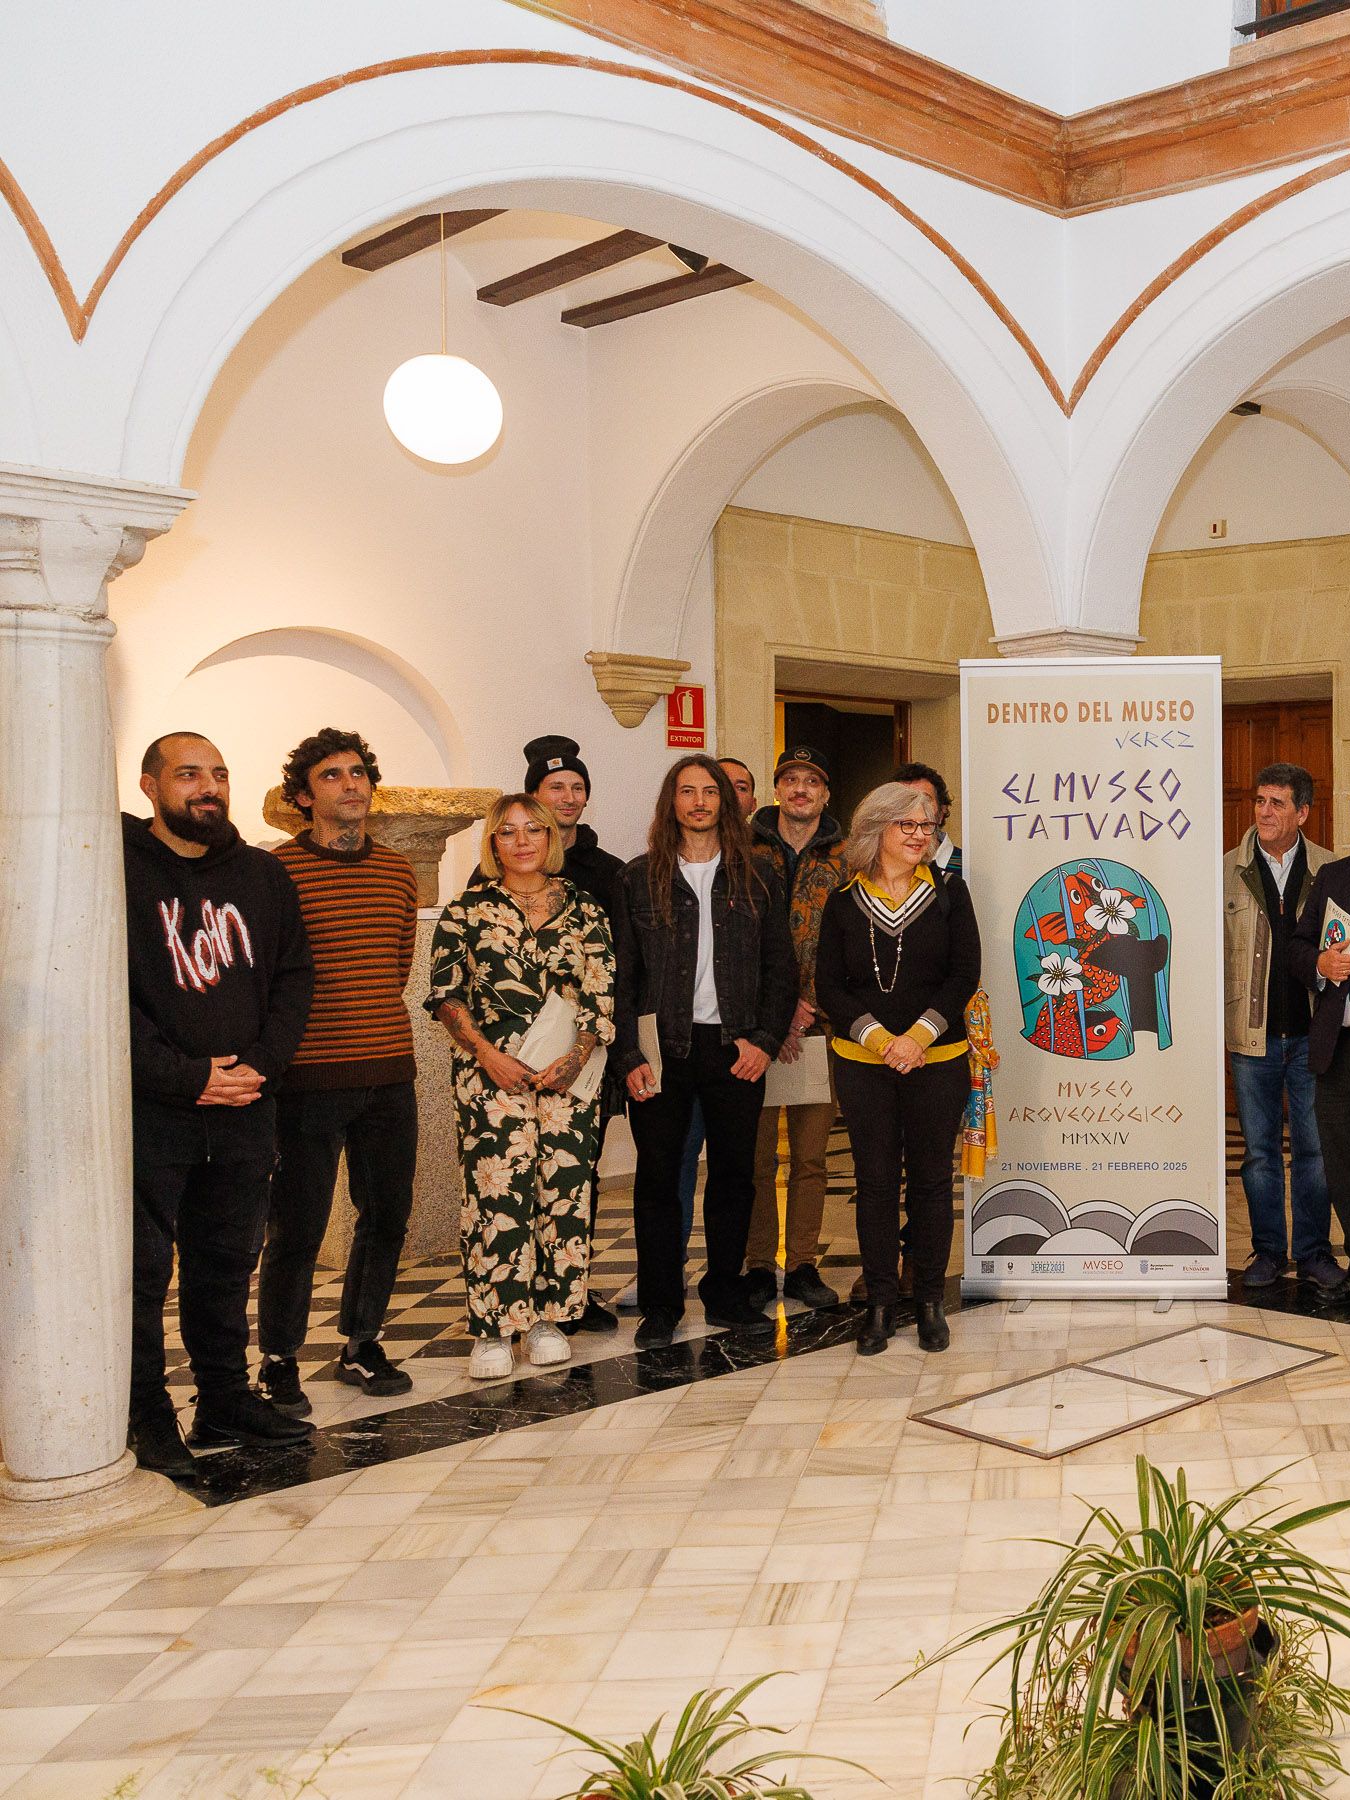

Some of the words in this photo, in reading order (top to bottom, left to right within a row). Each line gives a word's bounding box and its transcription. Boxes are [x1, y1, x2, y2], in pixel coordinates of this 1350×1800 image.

[987, 701, 1068, 723] DENTRO
[1078, 700, 1112, 722] DEL
[1122, 699, 1194, 722] MUSEO
[670, 735, 702, 743] EXTINTOR
[1002, 773, 1040, 804] EL
[1062, 1131, 1130, 1145] MMXXIV
[1001, 1162, 1012, 1171] 21
[1017, 1162, 1082, 1171] NOVIEMBRE
[1091, 1162, 1103, 1171] 21
[1107, 1161, 1159, 1171] FEBRERO
[1163, 1161, 1188, 1171] 2025
